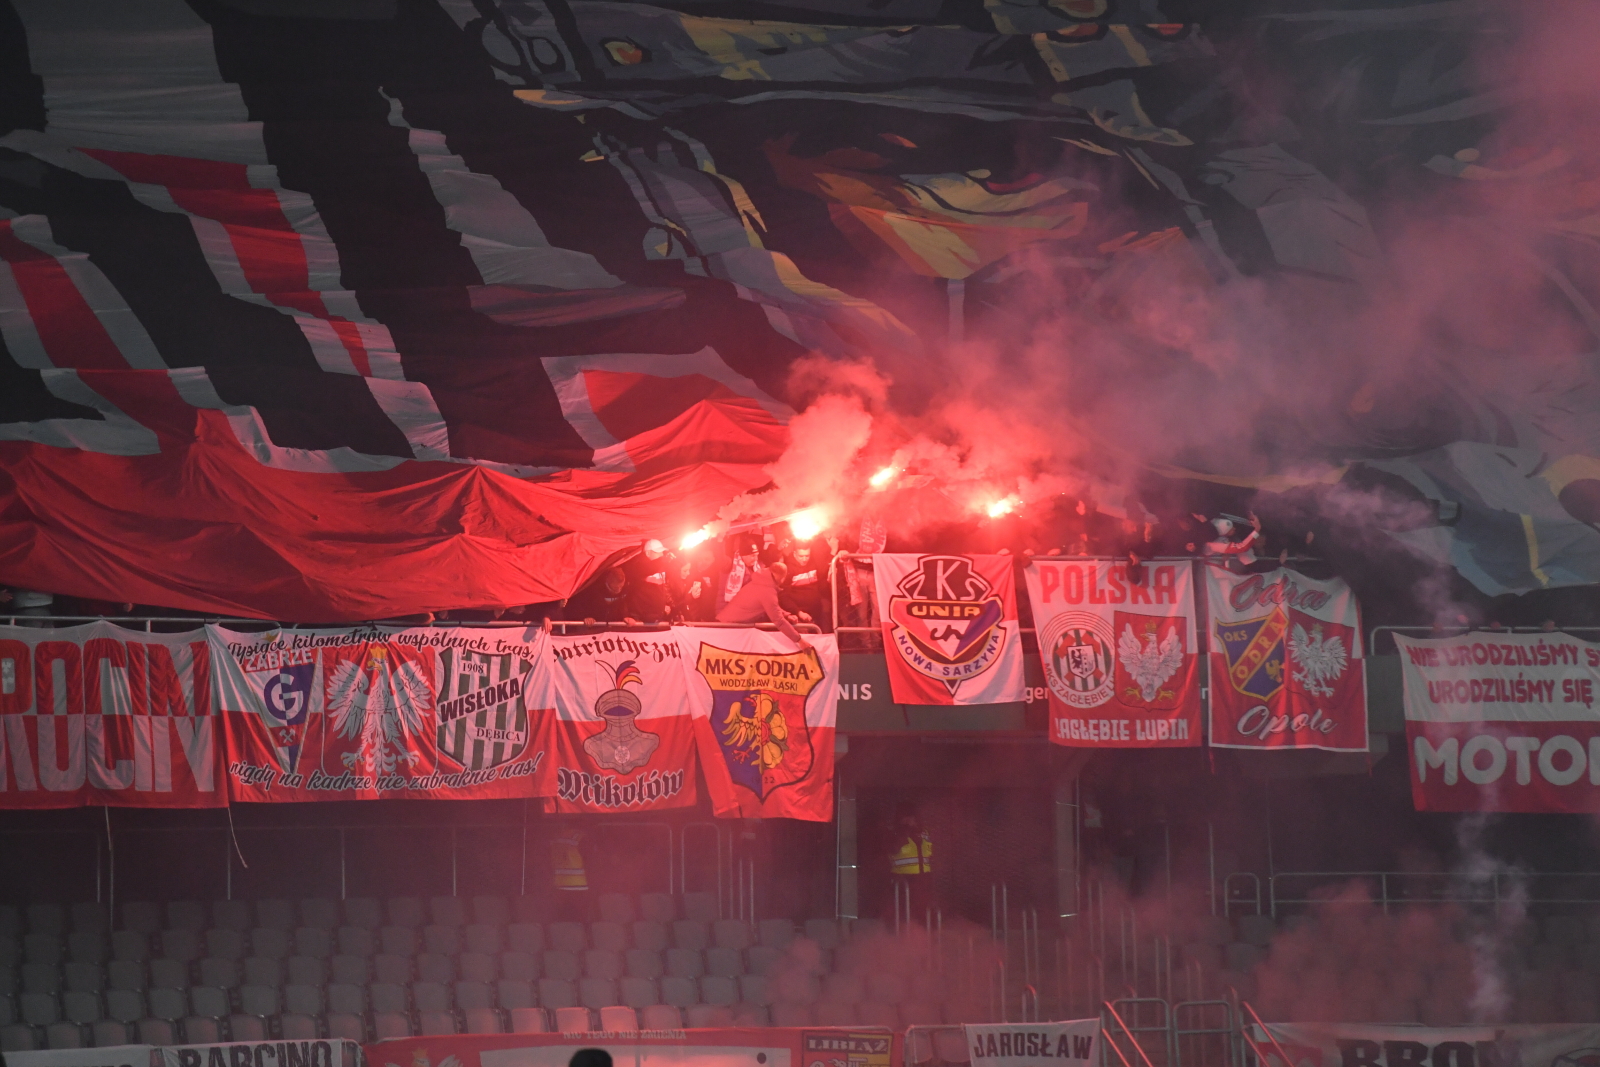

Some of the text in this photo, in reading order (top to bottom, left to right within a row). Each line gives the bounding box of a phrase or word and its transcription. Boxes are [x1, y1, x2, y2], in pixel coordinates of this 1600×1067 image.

[905, 560, 987, 600] ZKS
[1040, 565, 1177, 604] POLSKA
[1229, 574, 1332, 612] Odra
[911, 605, 980, 617] UNIA
[227, 628, 535, 665] Tysiące kilometrów wspólnych tras,
[1223, 630, 1248, 641] OKS
[1236, 621, 1284, 679] ODRA
[1406, 645, 1440, 667] NIE
[1445, 638, 1578, 667] URODZILIŚMY
[244, 648, 314, 671] ZABRZE
[462, 662, 484, 673] 1908
[705, 658, 810, 680] MKS ODRA
[898, 635, 999, 676] NOWA SARZYNA
[440, 677, 520, 723] WISŁOKA
[719, 678, 770, 688] WODZISŁAW
[1045, 663, 1059, 687] MKS
[1056, 686, 1108, 706] ZAGŁĘBIE
[1429, 672, 1594, 710] URODZILIŚMY SIĘ
[476, 727, 520, 742] DĘBICA
[1136, 718, 1189, 740] LUBIN
[1237, 705, 1337, 741] Opole
[230, 750, 544, 791] nigdy na kadrze nie zabraknie nas!
[974, 1032, 1093, 1060] JAROSŁAW
